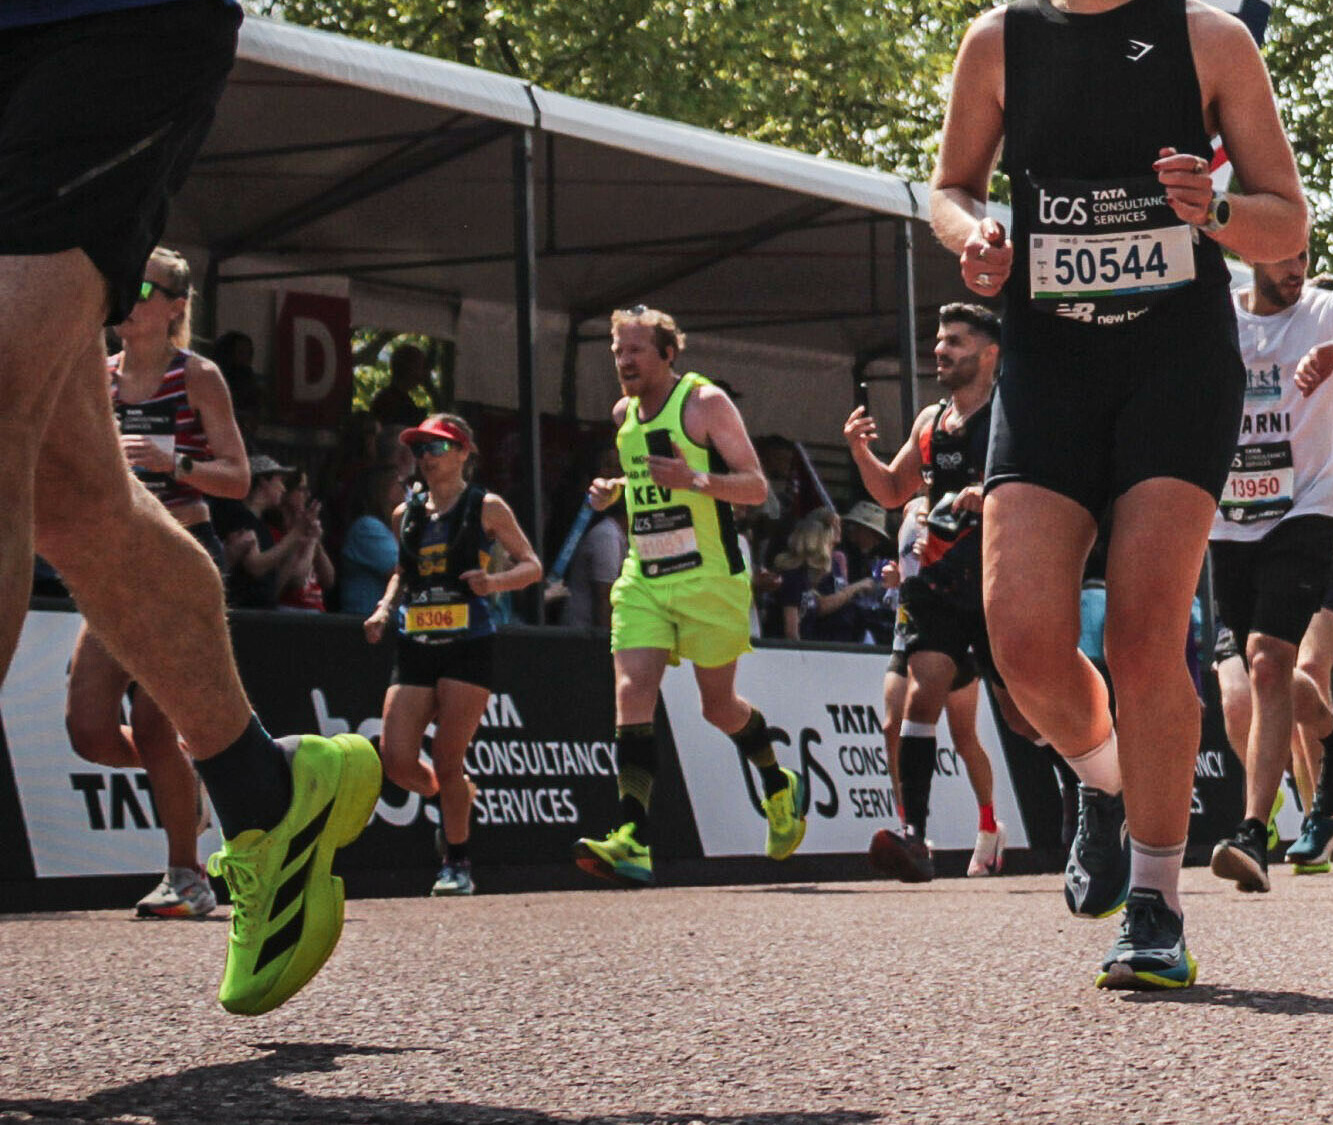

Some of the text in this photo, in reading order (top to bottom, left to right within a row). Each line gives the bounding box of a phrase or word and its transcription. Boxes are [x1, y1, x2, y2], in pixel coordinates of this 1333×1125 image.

[1039, 189, 1089, 226] tcs
[1091, 188, 1128, 201] TATA
[1091, 195, 1168, 214] CONSULTANC
[1093, 210, 1148, 226] SERVICES
[1054, 241, 1169, 286] 50544
[1097, 313, 1124, 326] new
[293, 316, 337, 400] D
[633, 485, 672, 506] KEV
[1230, 477, 1280, 499] 13950
[826, 704, 885, 735] TATA
[462, 741, 620, 776] CONSULTANCY
[838, 745, 961, 777] CONSCY
[472, 788, 579, 824] SERVICES
